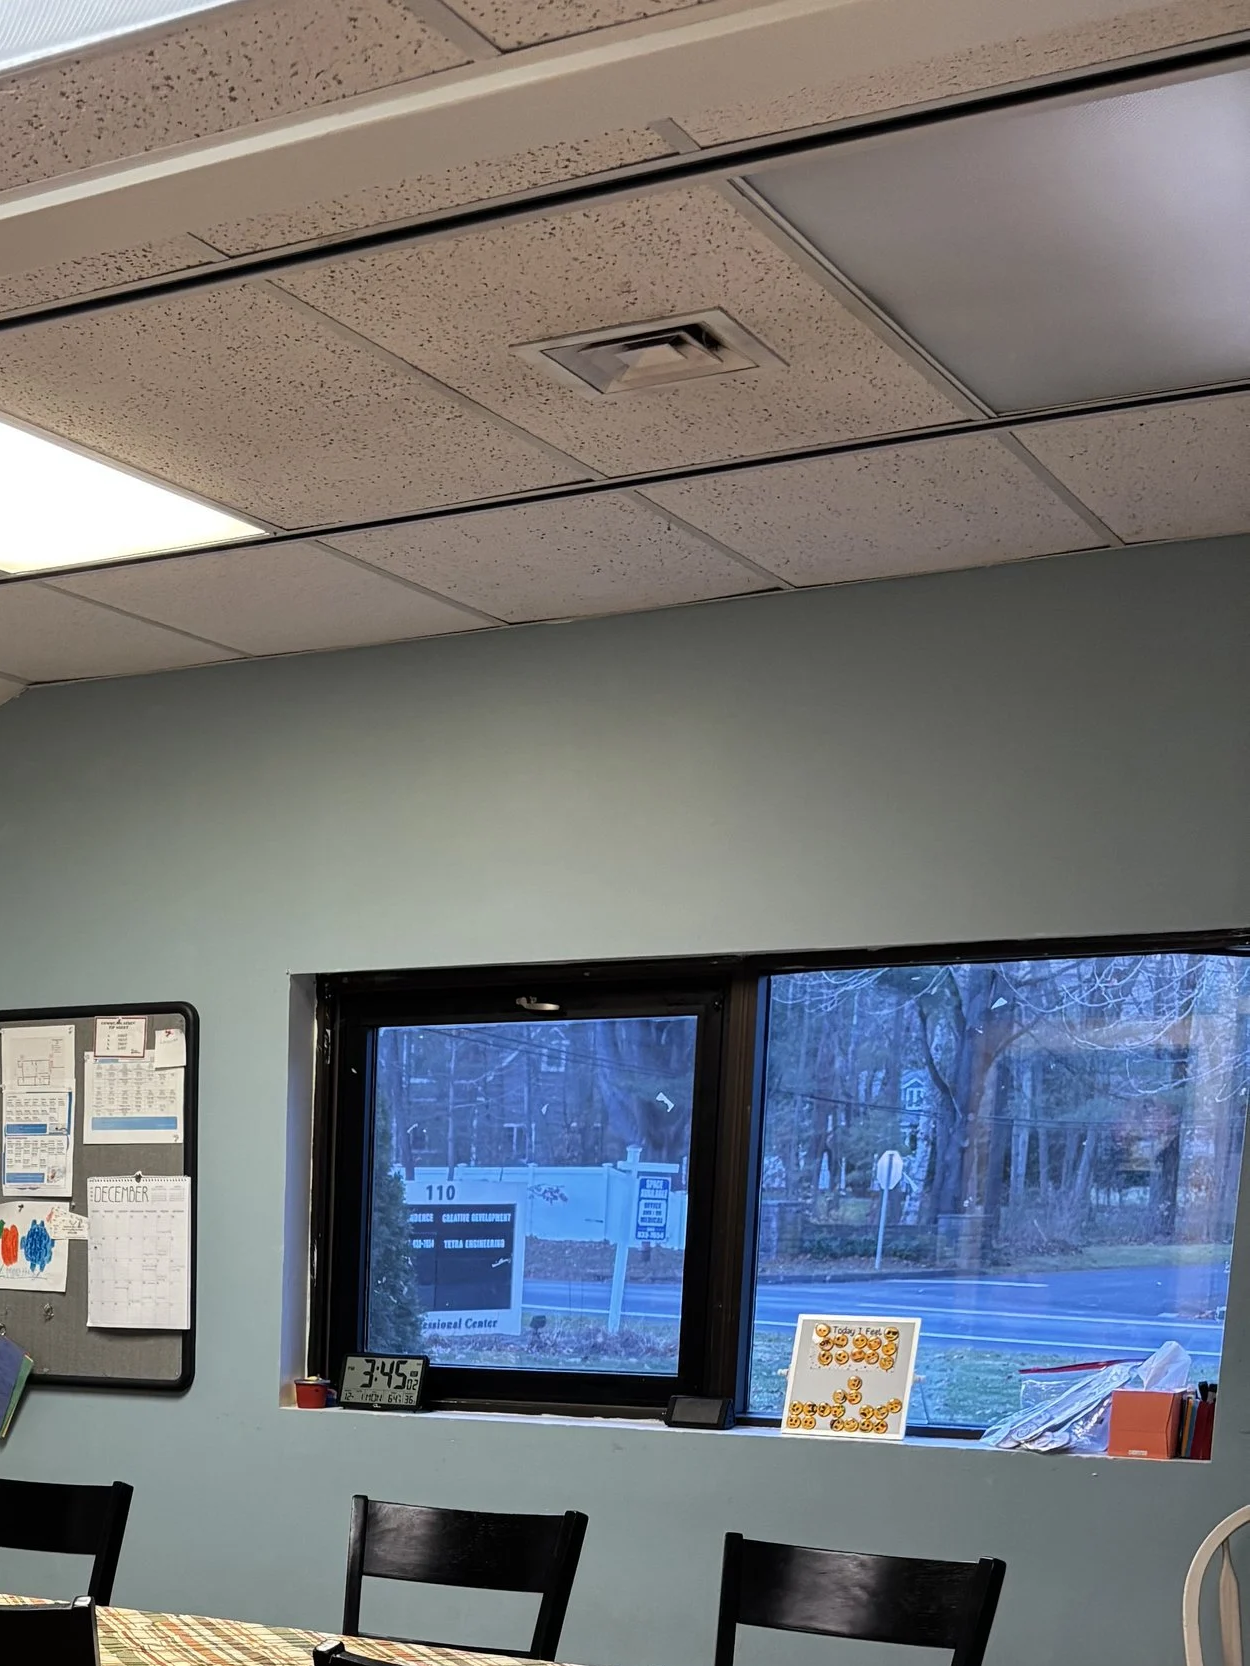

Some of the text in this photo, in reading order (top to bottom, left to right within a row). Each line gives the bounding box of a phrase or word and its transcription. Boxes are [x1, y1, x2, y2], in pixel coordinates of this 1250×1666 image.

[93, 1185, 149, 1203] DECEMBER
[426, 1184, 456, 1201] 110
[442, 1213, 511, 1223] CREATIVE DEVELOPMENT
[465, 1238, 505, 1249] ENGINEERING
[422, 1317, 499, 1330] essional Center
[833, 1326, 855, 1337] Today
[865, 1327, 882, 1336] Feel
[360, 1358, 408, 1390] 3:45
[406, 1378, 419, 1391] 02
